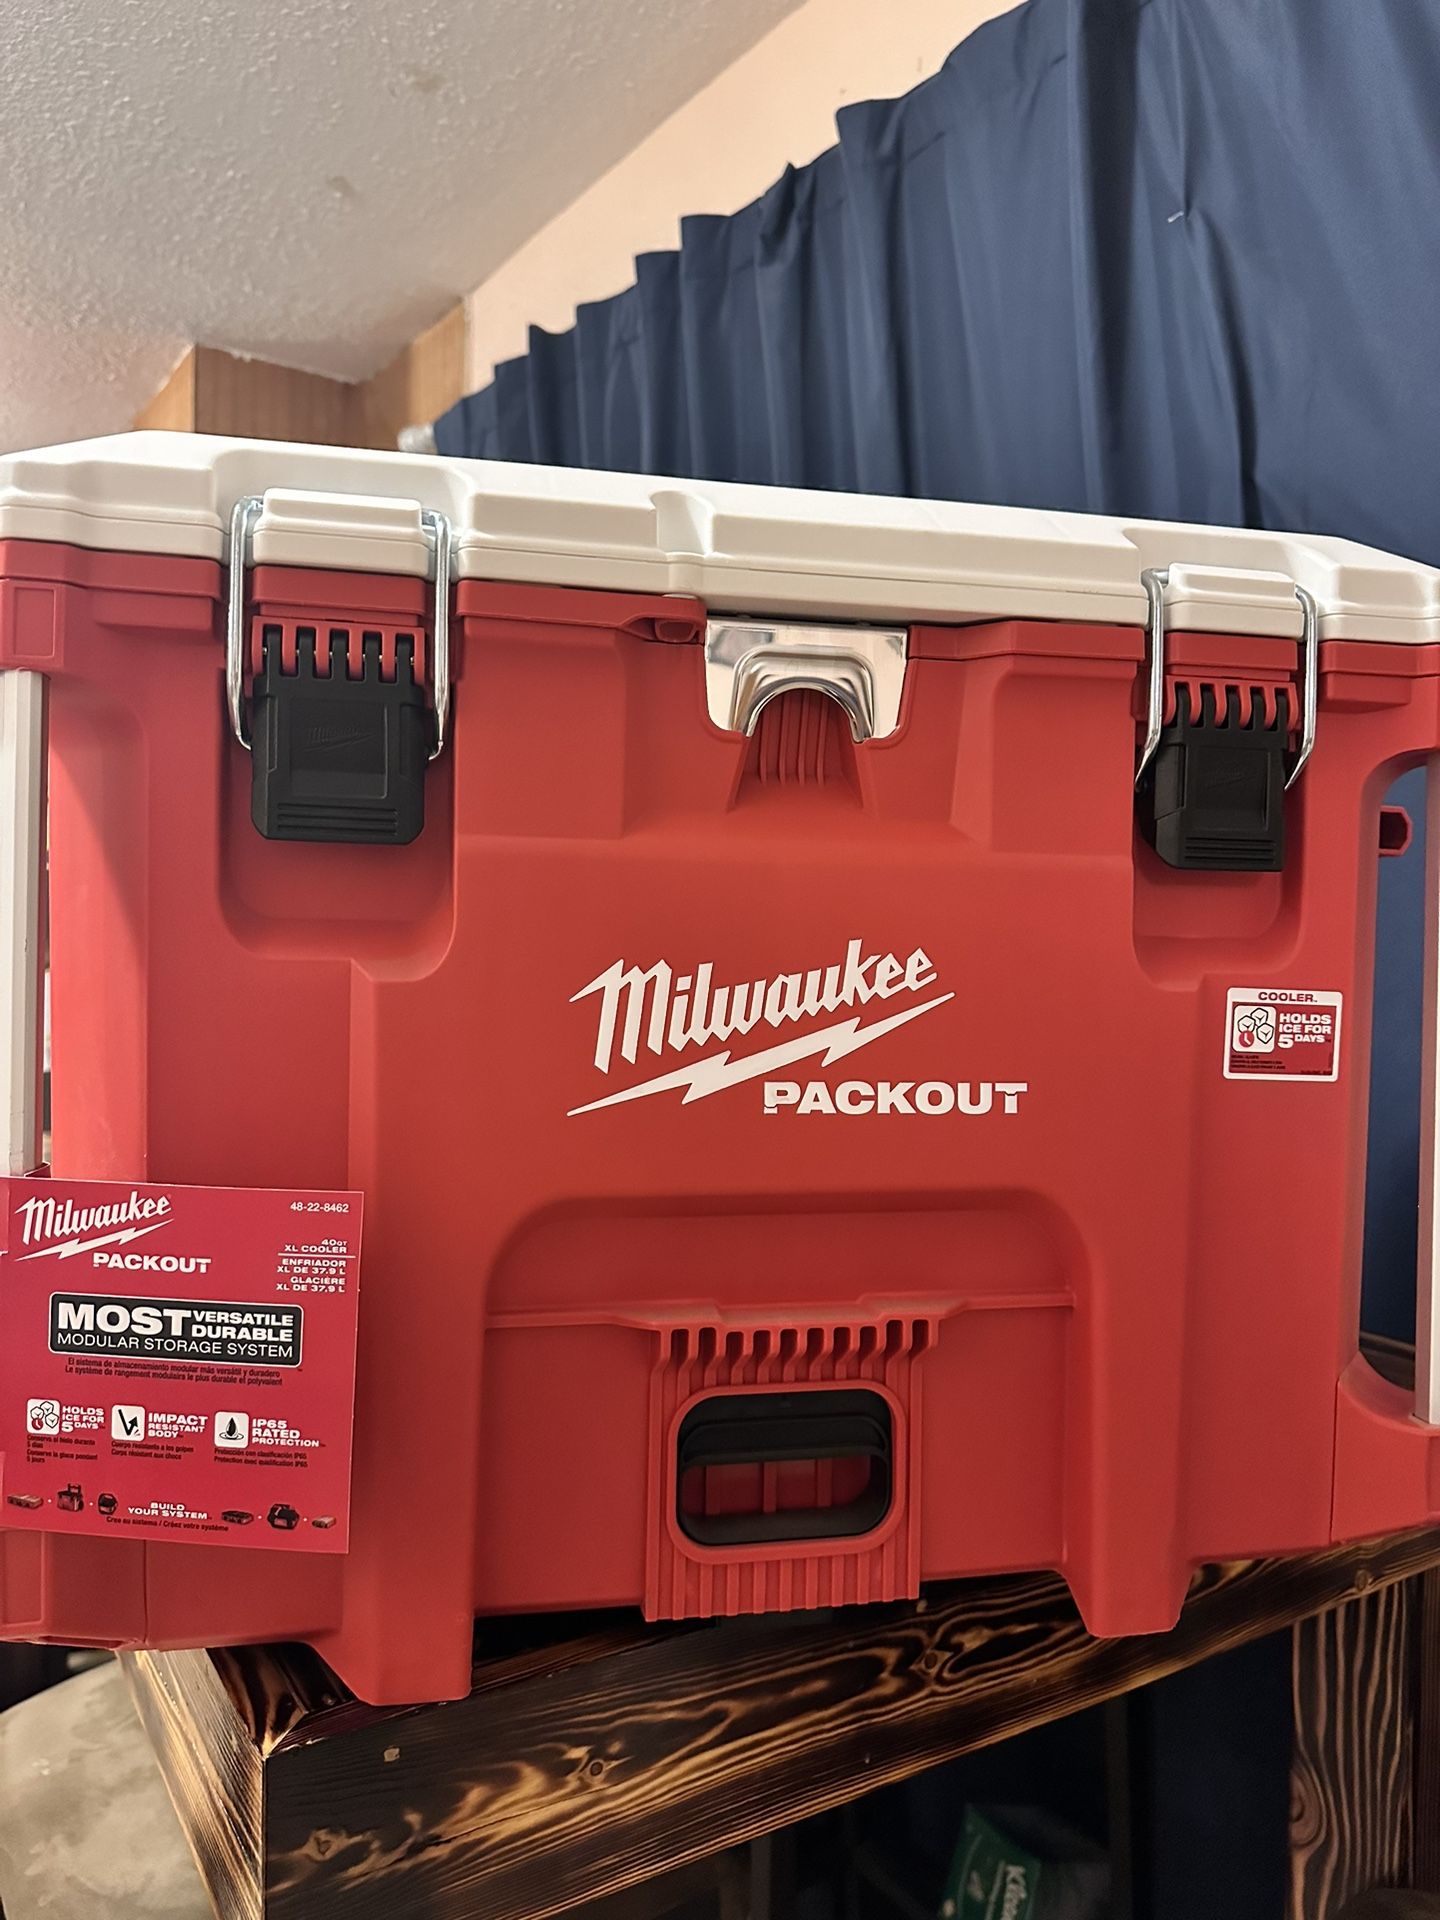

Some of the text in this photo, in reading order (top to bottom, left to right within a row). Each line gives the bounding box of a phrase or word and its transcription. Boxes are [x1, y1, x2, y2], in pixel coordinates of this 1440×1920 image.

[569, 938, 937, 1075] Milwaukee
[1280, 1013, 1331, 1024] HOLDS
[1279, 1023, 1331, 1034] ICE FOR
[1277, 1034, 1325, 1049] 5 DAYS
[763, 1080, 1028, 1116] PACKOUT
[290, 1202, 349, 1213] 48-22-8462
[14, 1191, 172, 1246] Milwaukee
[284, 1244, 347, 1254] XL COOLER
[93, 1252, 211, 1274] PACKOUT
[282, 1258, 346, 1268] ENFRIADOR
[277, 1265, 290, 1273] XL
[293, 1266, 308, 1274] DE
[311, 1267, 336, 1275] 37.9
[276, 1283, 290, 1291] XL
[311, 1285, 335, 1293] 37.9
[338, 1285, 345, 1293] L
[58, 1302, 294, 1337] MOST VERSATILE
[191, 1324, 293, 1342] DURABLE
[57, 1333, 293, 1358] MODULAR STORAGE SYSTEM
[62, 1406, 104, 1415] HOLDS
[62, 1414, 104, 1423] ICE FOR
[148, 1412, 208, 1425] IMPACT
[252, 1418, 287, 1429] IP65
[61, 1421, 74, 1432] 5
[148, 1423, 205, 1433] RESISTANT
[148, 1430, 178, 1438] BODY
[252, 1428, 301, 1439] RATED
[252, 1437, 320, 1447] PROTECTION
[150, 1502, 185, 1511] BUILD
[128, 1507, 207, 1519] YOUR SYSTEM
